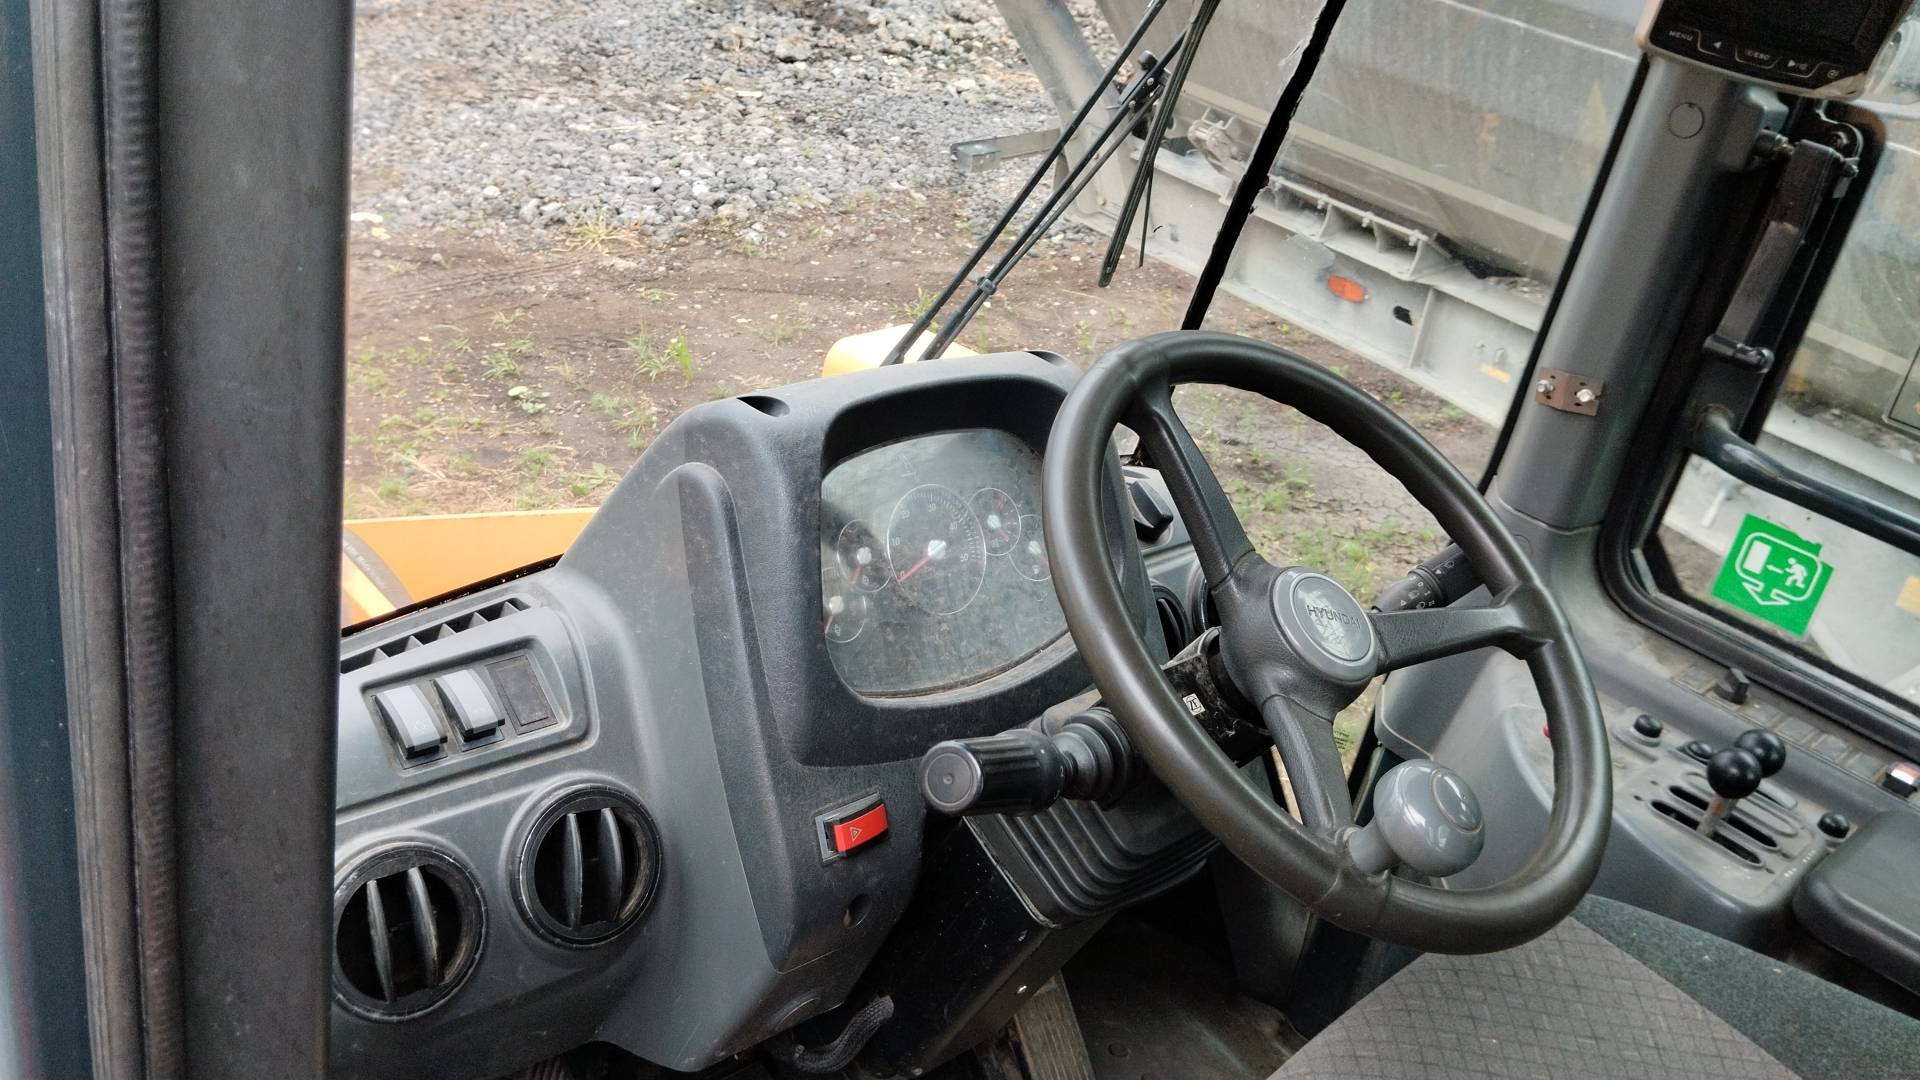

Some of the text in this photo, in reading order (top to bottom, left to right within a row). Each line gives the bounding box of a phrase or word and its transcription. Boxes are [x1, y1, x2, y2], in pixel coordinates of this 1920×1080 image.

[1668, 30, 1694, 41] MENU
[892, 536, 900, 546] 10
[1306, 604, 1361, 630] HYUNDAI
[1186, 697, 1202, 711] ZF
